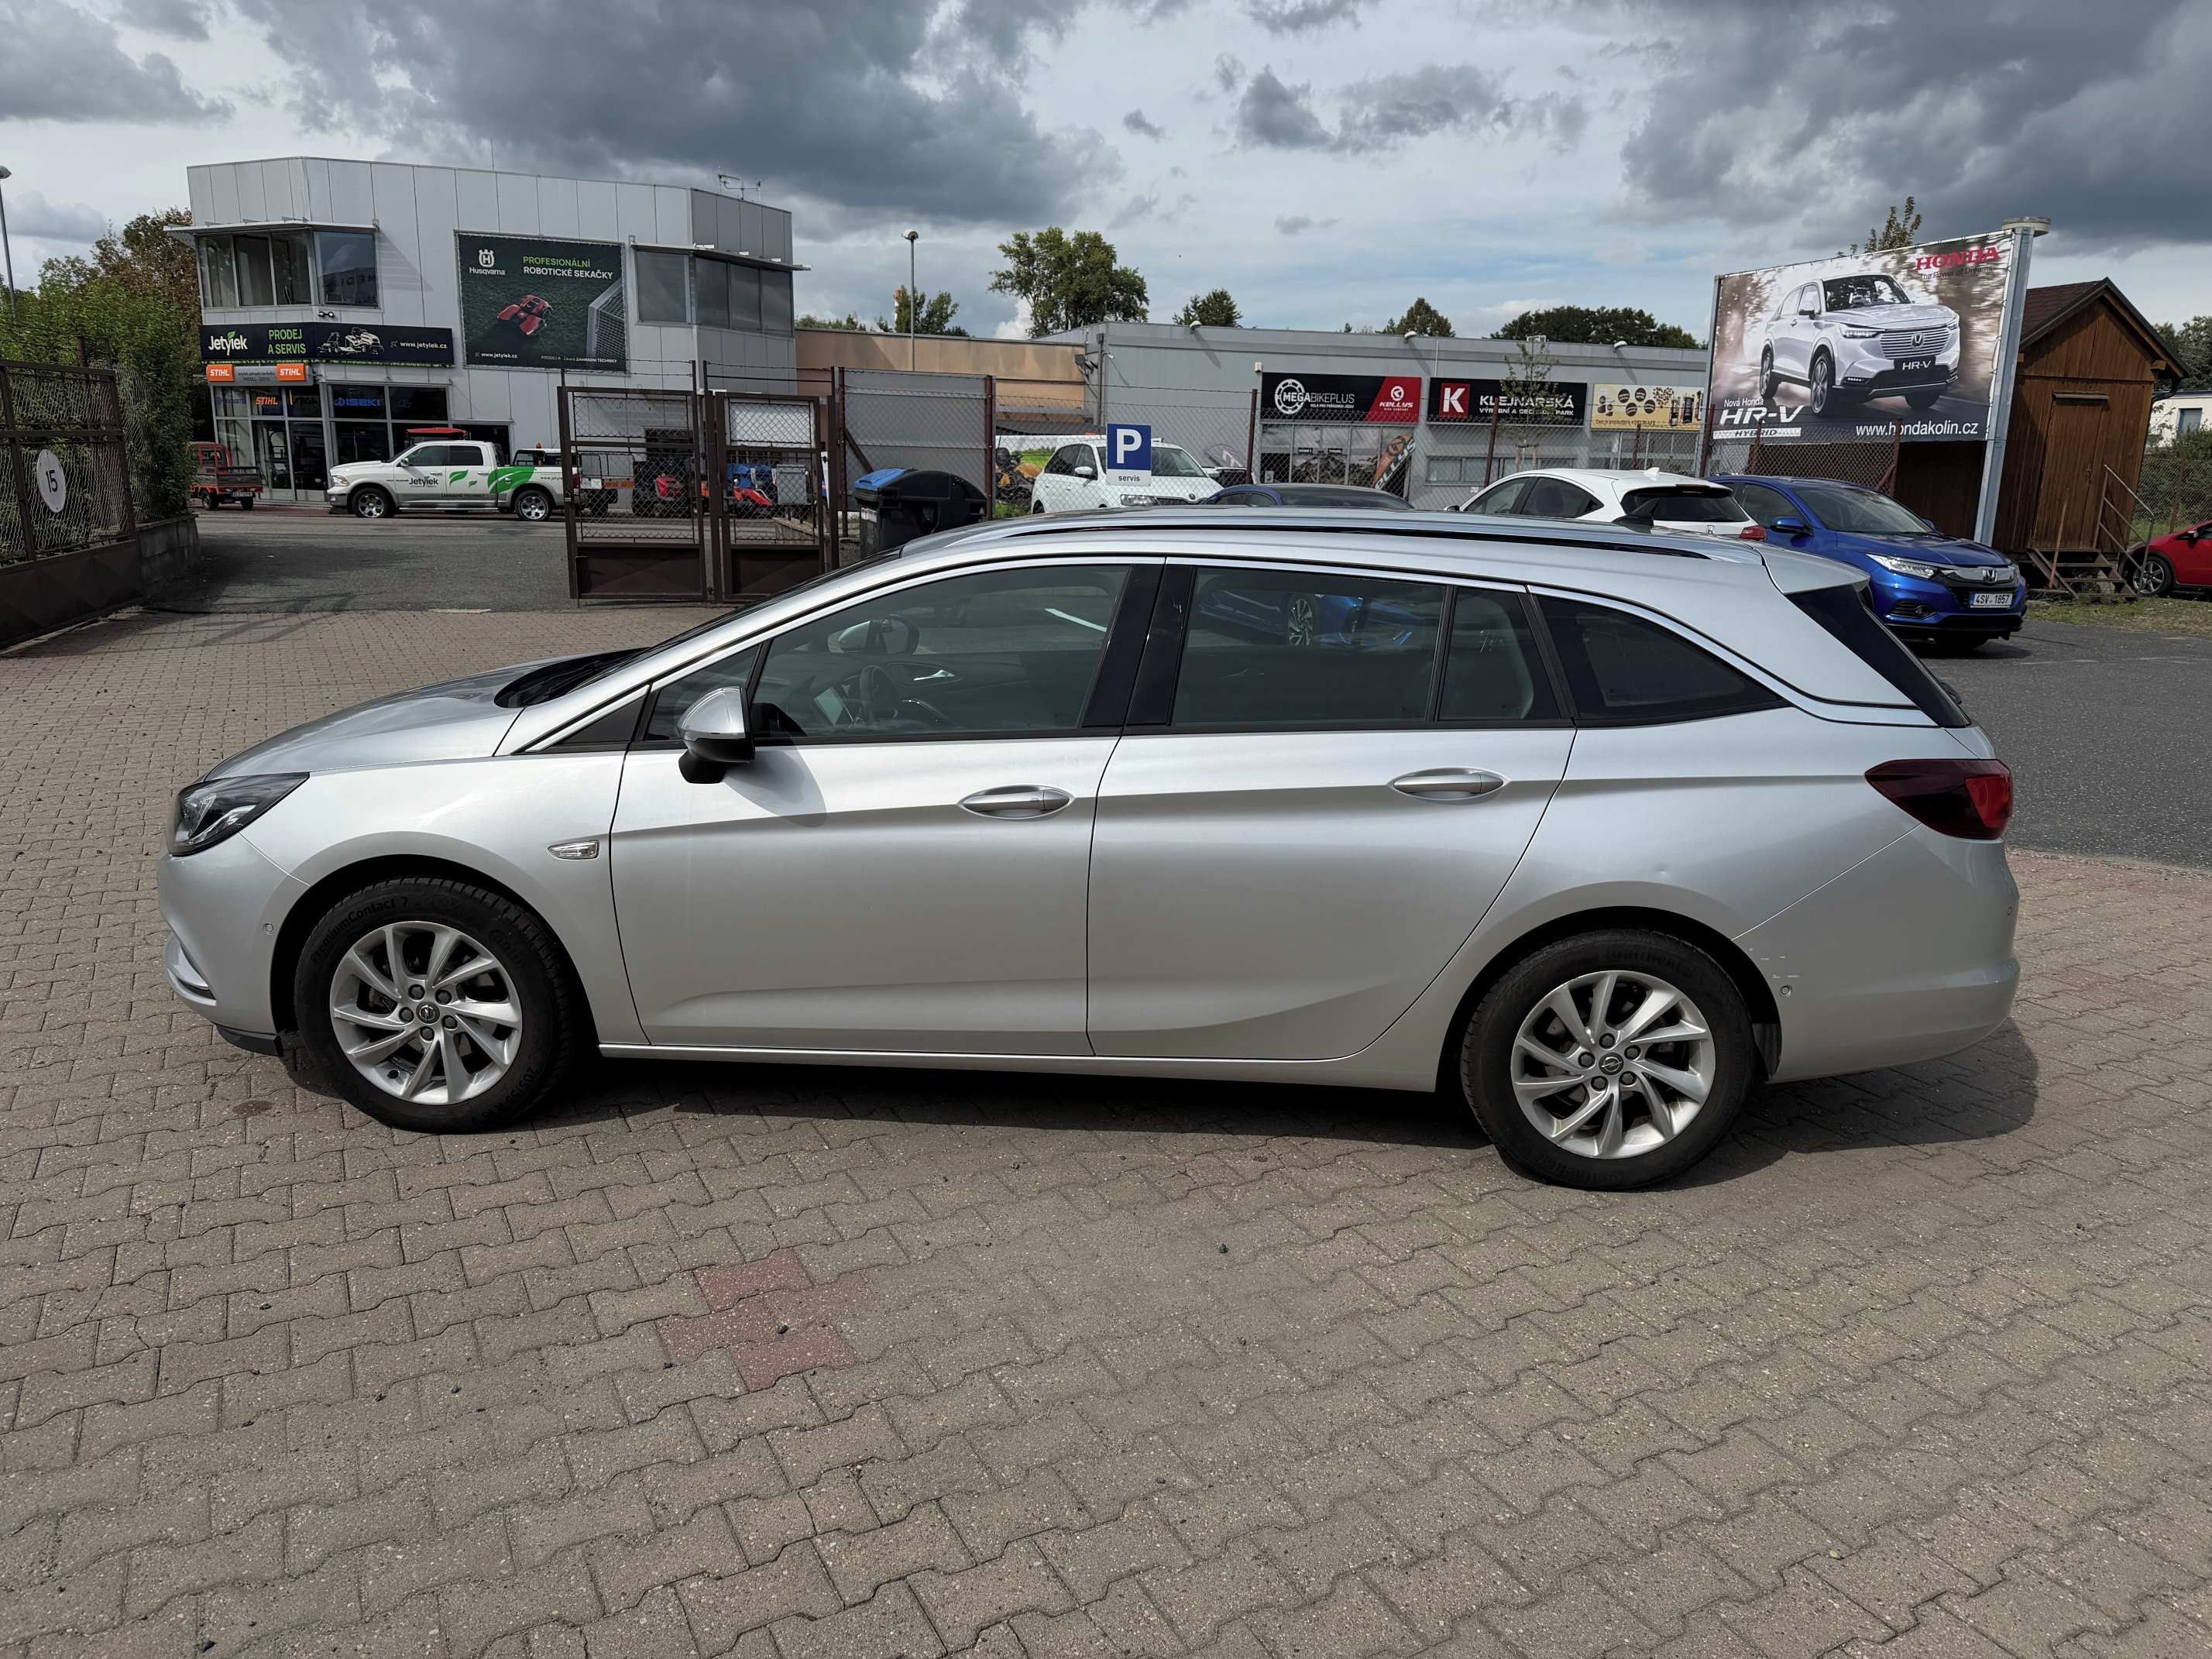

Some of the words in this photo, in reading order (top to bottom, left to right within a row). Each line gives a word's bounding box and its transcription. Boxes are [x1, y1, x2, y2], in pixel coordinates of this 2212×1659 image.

[523, 256, 590, 267] PROFESIONÁLNÍ
[1915, 246, 2001, 270] HONDA
[469, 266, 506, 276] Husqvarna
[524, 266, 572, 276] ROBOTICKÉ
[574, 269, 613, 280] SEKAČKY
[1933, 270, 1955, 279] Power
[269, 328, 302, 339] PRODEJ
[268, 344, 274, 355] A
[275, 343, 306, 355] SERVIS
[1902, 360, 1931, 370] HR-V
[256, 396, 278, 405] STIHL
[346, 398, 380, 407] ISEKI
[1283, 392, 1355, 404] MEGABIKEPLUS
[1723, 397, 1740, 407] Nová
[1741, 397, 1764, 406] Honda
[1719, 404, 1805, 424] HR-V
[1116, 428, 1142, 463] P
[46, 469, 58, 493] 15
[1976, 594, 1989, 604] 4SV
